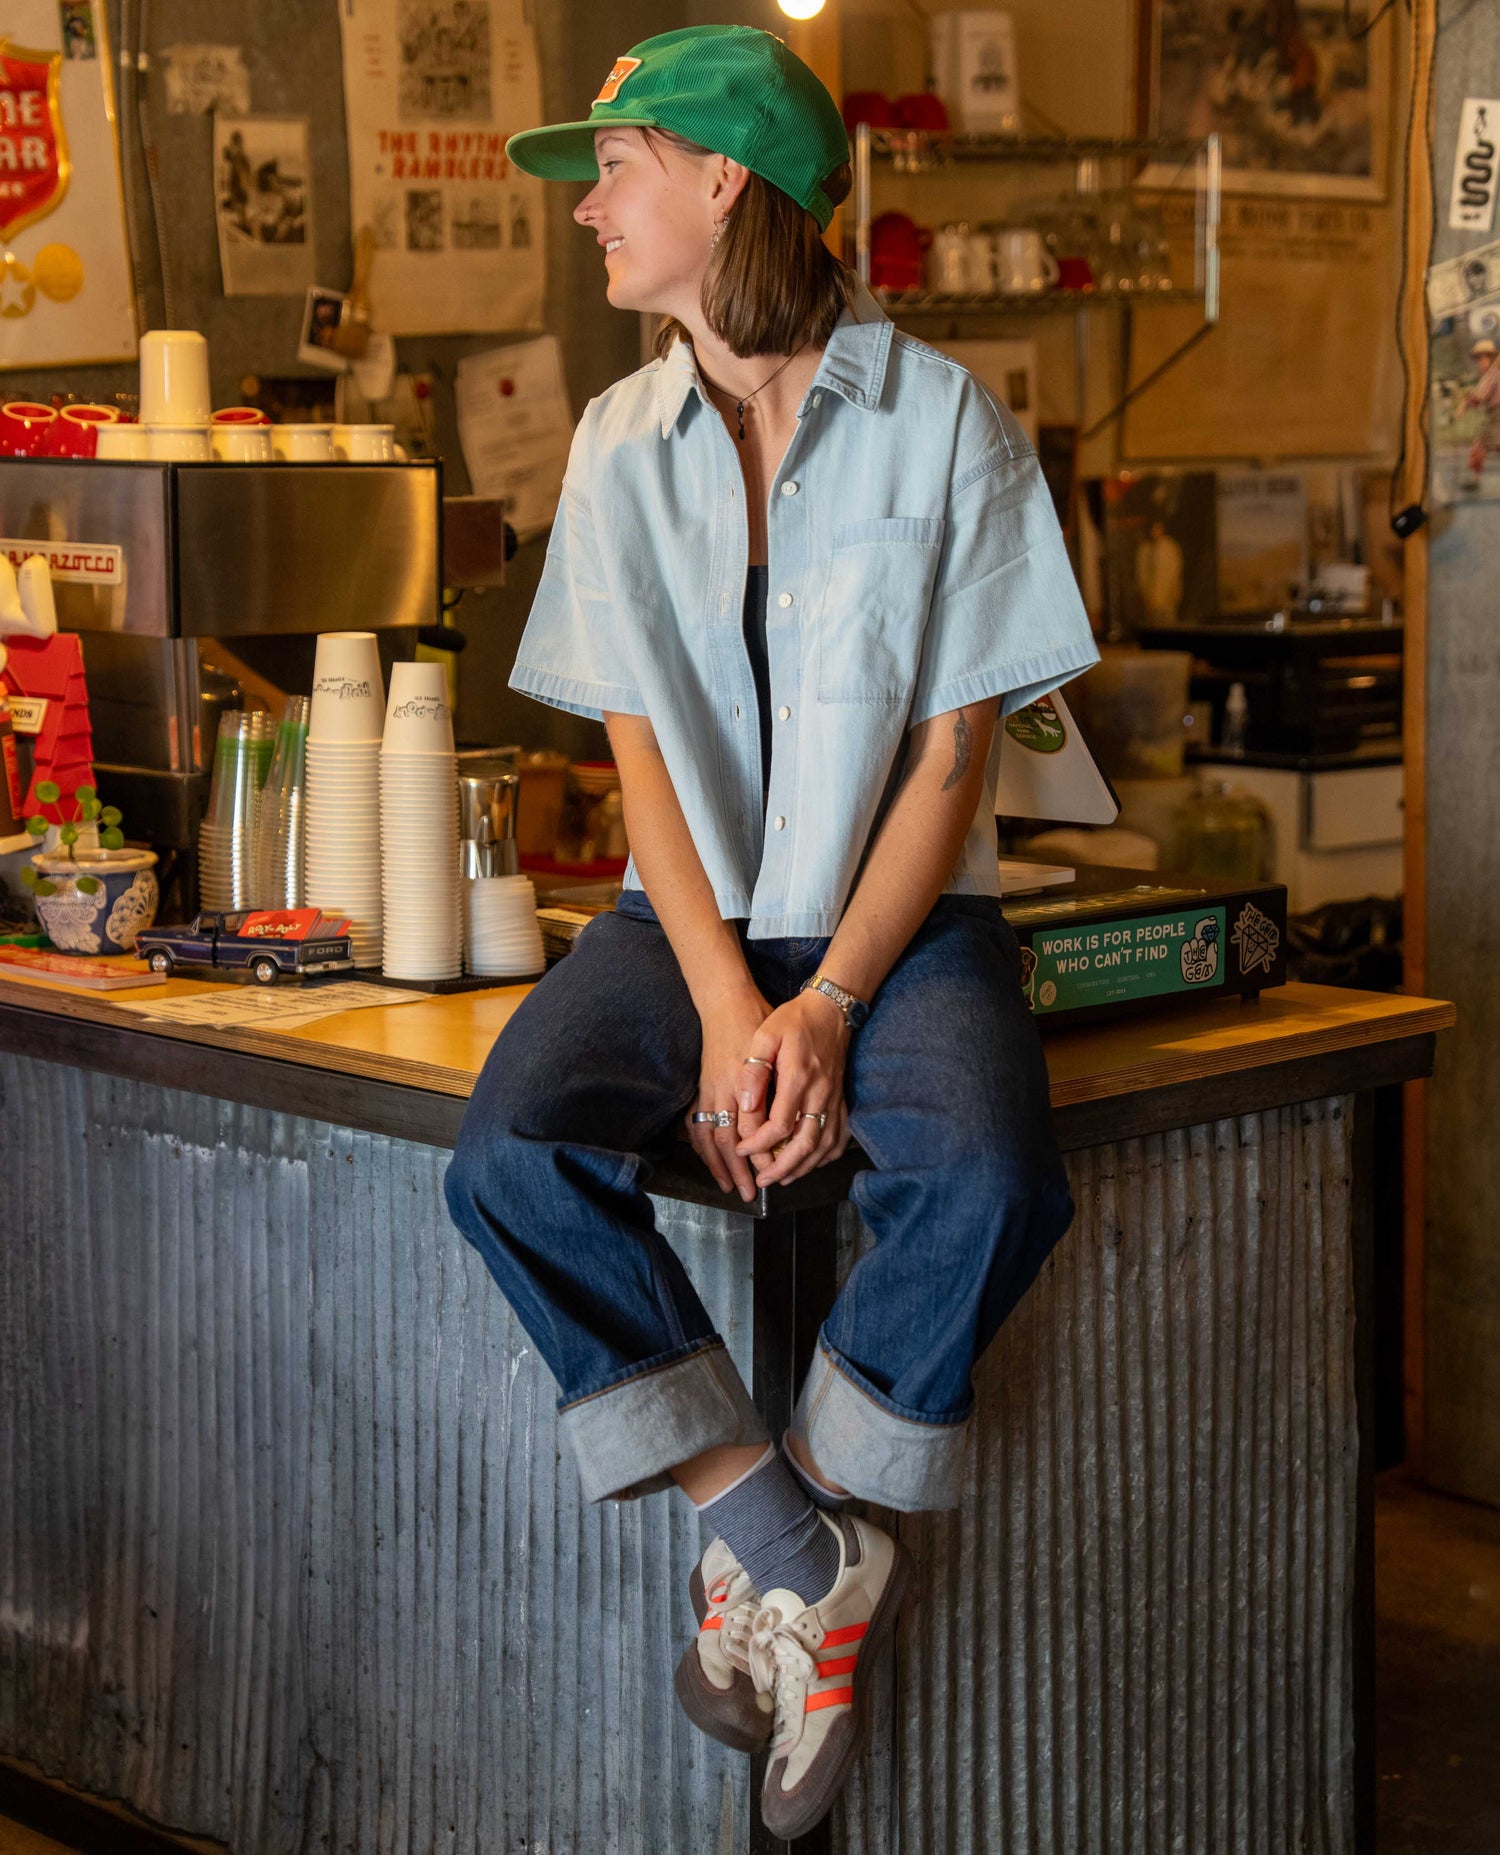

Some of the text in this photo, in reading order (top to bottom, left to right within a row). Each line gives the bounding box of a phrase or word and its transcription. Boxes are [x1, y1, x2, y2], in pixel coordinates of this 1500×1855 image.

[378, 131, 416, 152] THE
[392, 155, 508, 179] RAMBLERS
[1042, 921, 1186, 956] WORK IS FOR PEOPLE
[308, 946, 343, 955] FORD
[1056, 944, 1168, 974] WHO CAN'T FIND
[1184, 945, 1207, 964] THE
